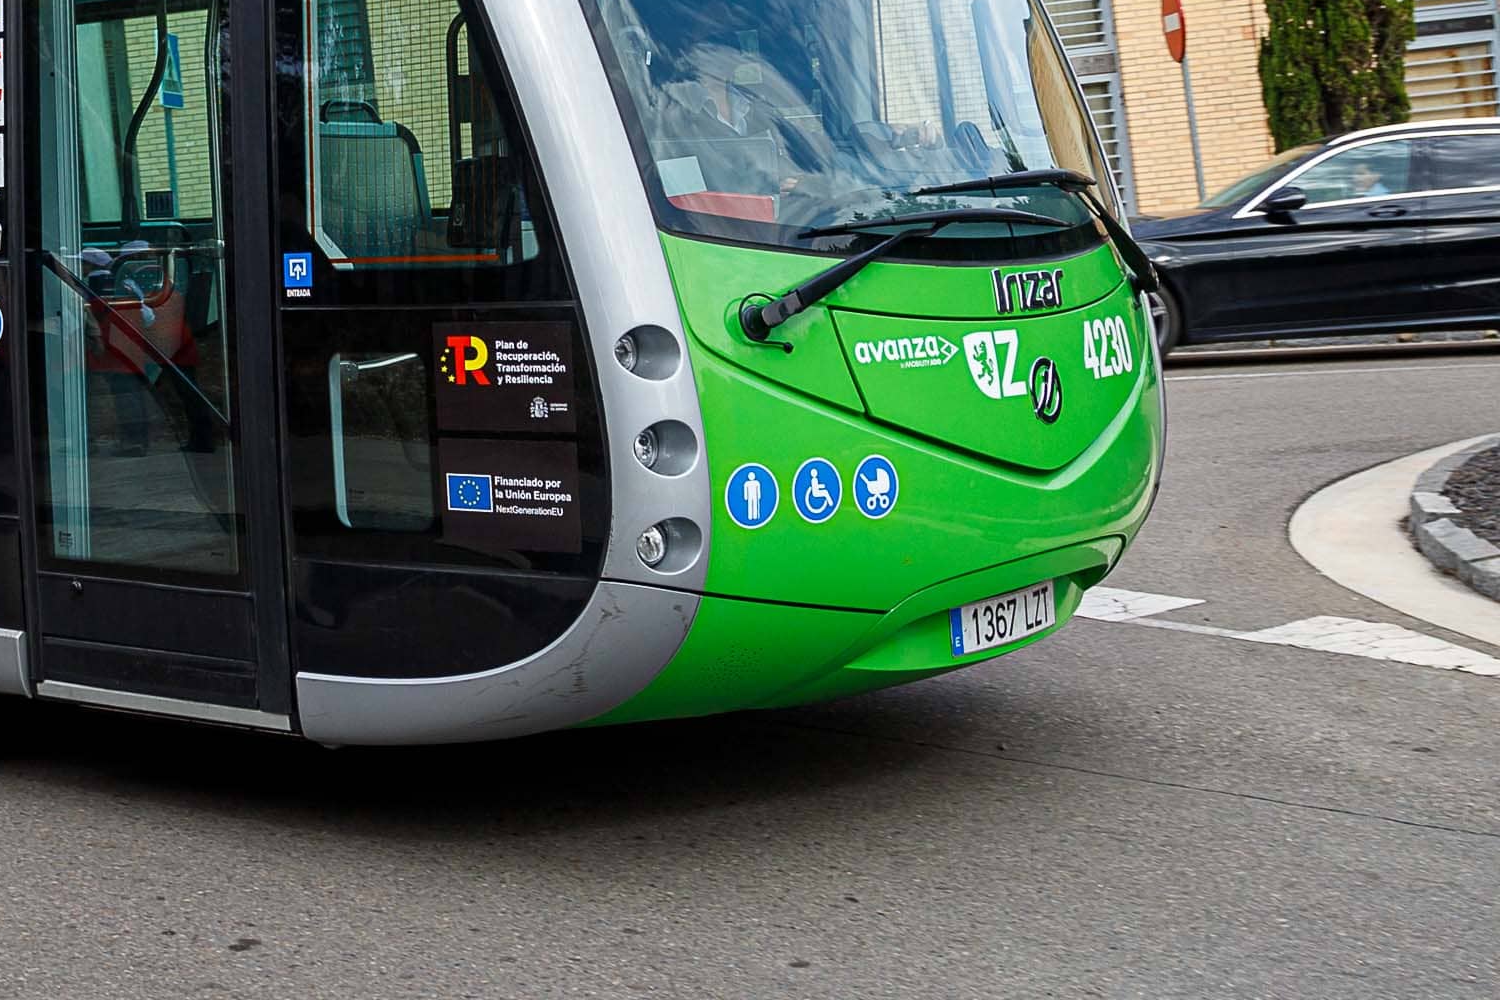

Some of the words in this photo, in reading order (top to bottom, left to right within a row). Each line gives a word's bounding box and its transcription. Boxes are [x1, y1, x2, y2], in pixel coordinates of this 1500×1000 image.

[287, 289, 311, 297] ENTRADA
[991, 269, 1064, 314] Irizar
[495, 341, 515, 350] Plan
[516, 341, 529, 350] de
[855, 336, 940, 363] avanza
[1084, 315, 1133, 380] 4230
[496, 351, 560, 363] Recuperación,
[496, 363, 566, 373] Transformación
[497, 376, 503, 385] y
[505, 375, 553, 385] Resiliencia
[494, 476, 544, 487] Financiado
[545, 479, 562, 489] por
[495, 488, 504, 499] la
[506, 488, 530, 500] Unión
[533, 491, 572, 504] Europea
[496, 504, 564, 517] NextGenerationEU
[972, 598, 1017, 646] 1367
[1024, 586, 1049, 631] LZT
[955, 636, 962, 648] E
